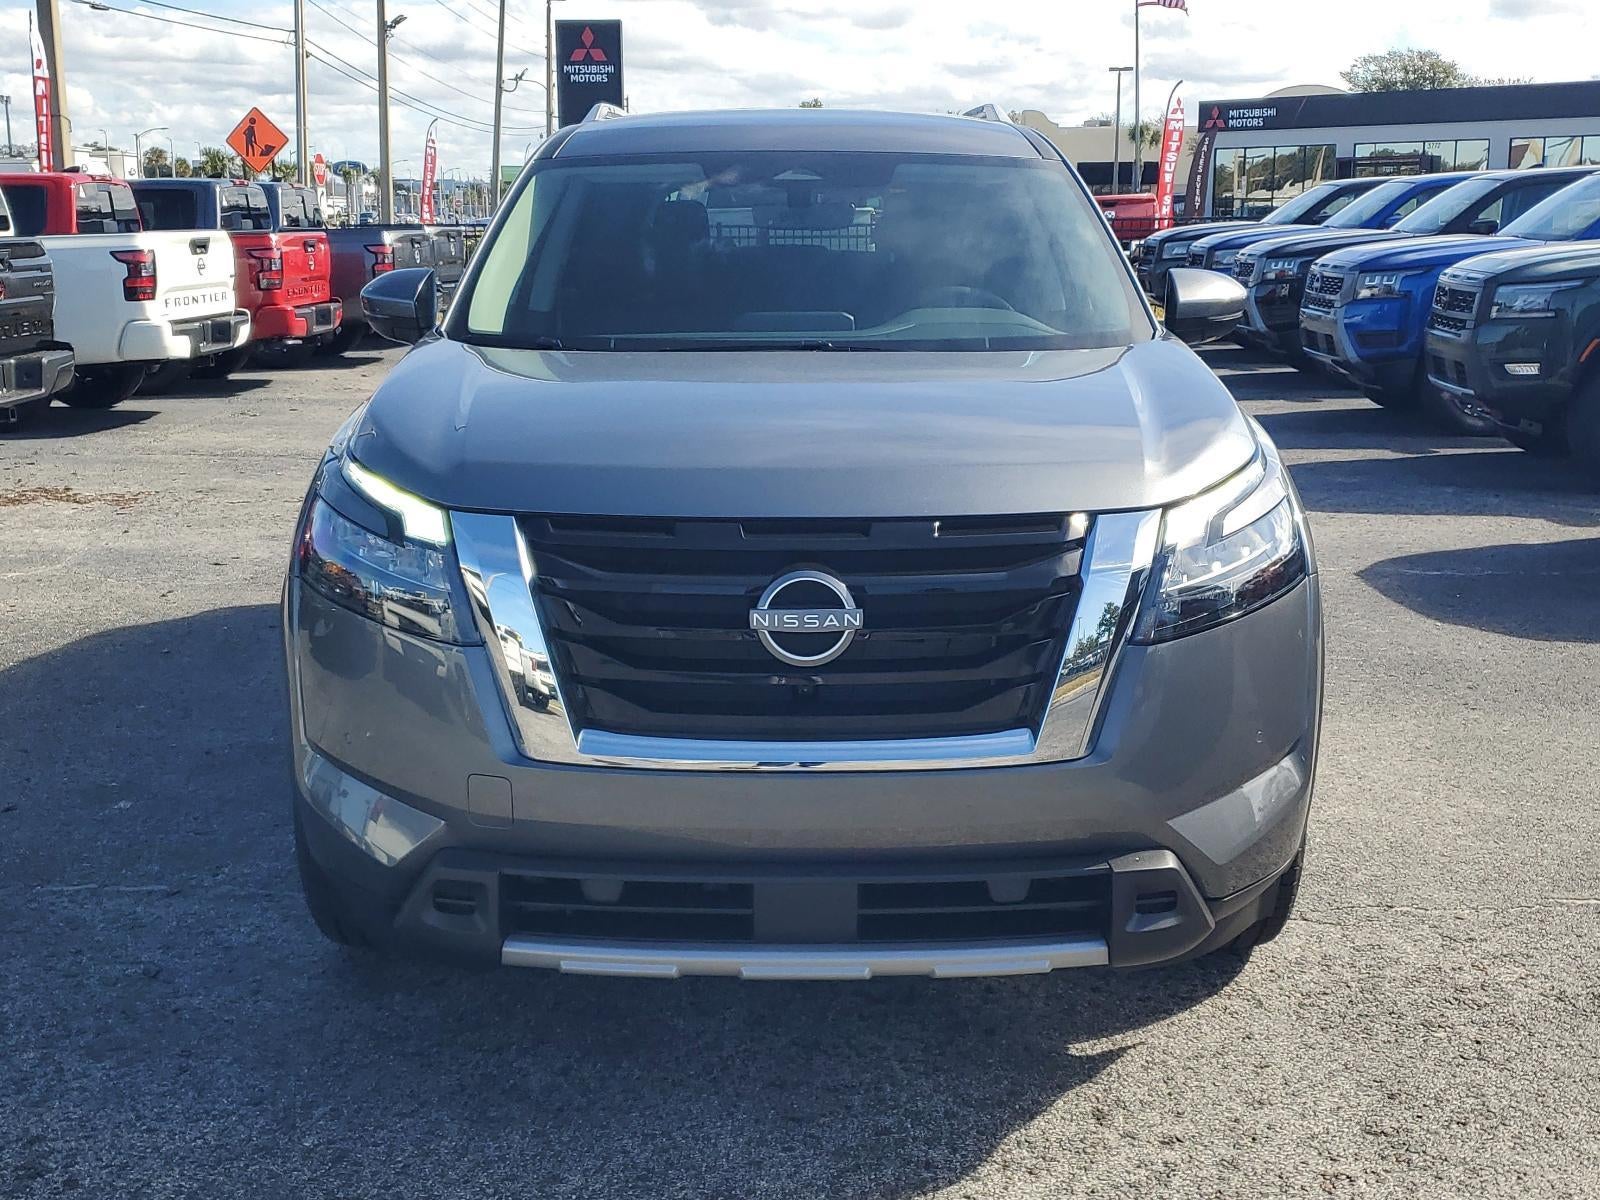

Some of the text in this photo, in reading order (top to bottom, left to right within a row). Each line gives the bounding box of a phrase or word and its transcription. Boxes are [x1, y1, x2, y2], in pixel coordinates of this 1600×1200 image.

[563, 64, 615, 73] MITSUBISHI
[570, 74, 608, 83] MOTORS
[1228, 107, 1277, 119] MITSUBISHI
[1228, 118, 1264, 128] MOTORS
[1193, 136, 1210, 210] SALES EVENT
[286, 283, 326, 297] FRONTIER
[164, 291, 228, 309] FRONTIER
[753, 613, 860, 628] NISSAN
